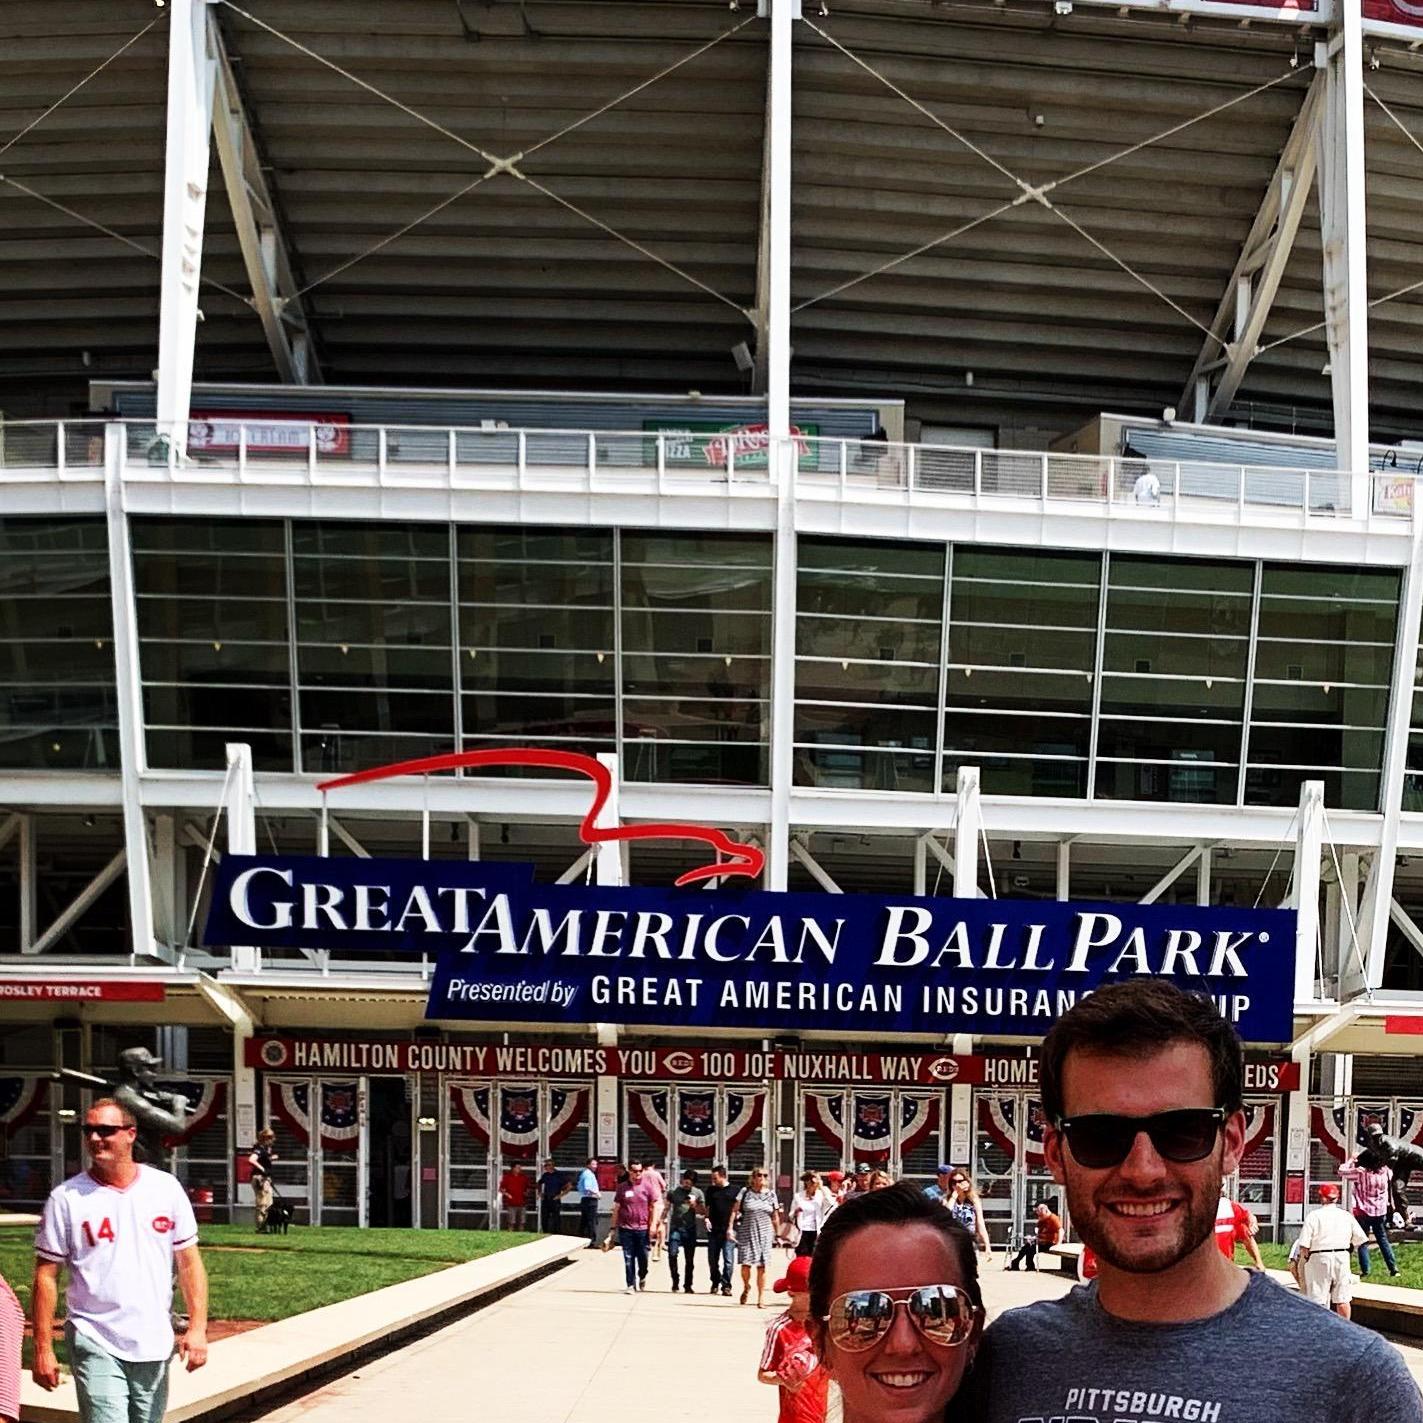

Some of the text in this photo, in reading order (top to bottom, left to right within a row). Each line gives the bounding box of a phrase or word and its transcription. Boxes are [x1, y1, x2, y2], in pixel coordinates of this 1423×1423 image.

[229, 866, 487, 934] GREAT
[460, 893, 846, 964] AMERICAN
[47, 985, 102, 998] TERRACE
[447, 974, 1094, 1017] Presented by GREAT AMERICAN INSURAN
[294, 1042, 657, 1075] HAMILTON COUNTY WELCOMES YOU
[700, 1052, 923, 1082] 100 JOE NUXHALL WAY
[984, 1058, 1279, 1089] HOME EDS
[81, 1217, 115, 1248] 14
[1065, 1387, 1222, 1423] PITTSBURGH
